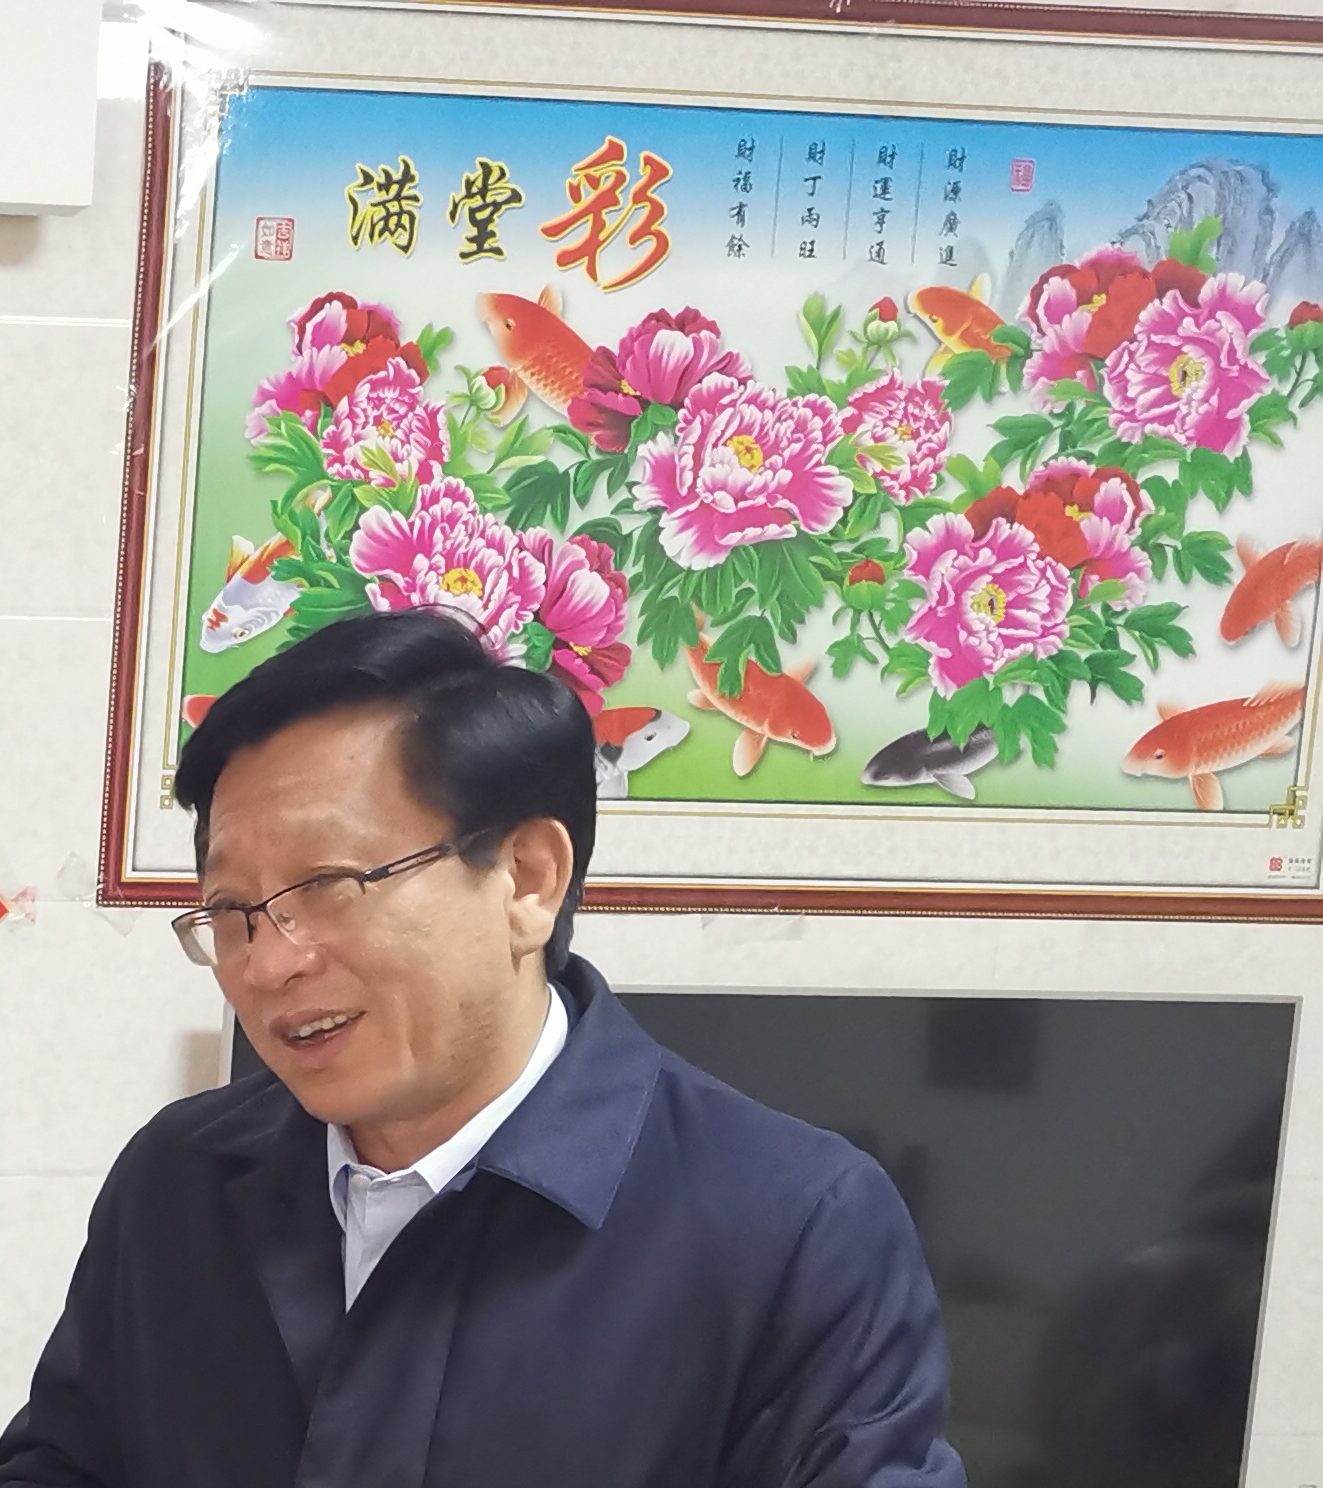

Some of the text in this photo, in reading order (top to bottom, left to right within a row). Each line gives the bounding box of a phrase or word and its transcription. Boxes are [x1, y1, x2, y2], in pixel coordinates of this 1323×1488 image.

[345, 134, 673, 293] 满堂彩
[725, 136, 756, 260] 財福有餘
[867, 143, 898, 266] 財運亨通
